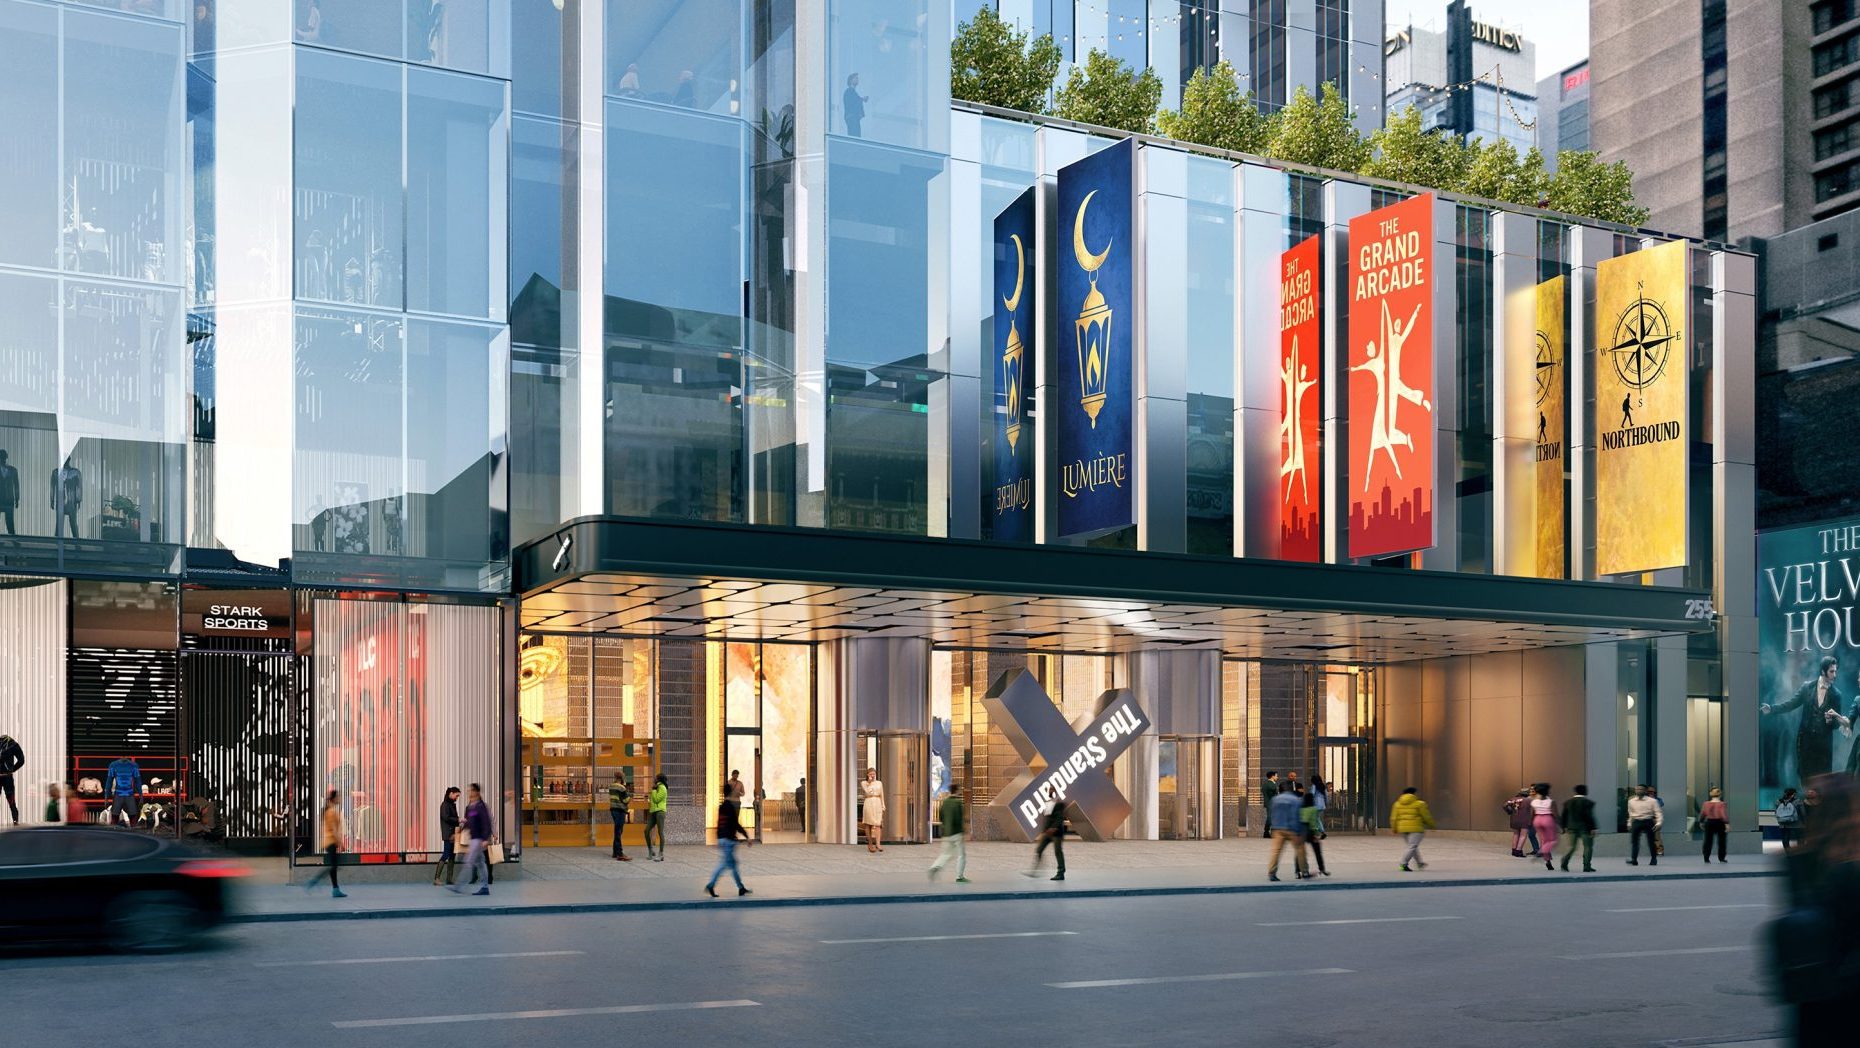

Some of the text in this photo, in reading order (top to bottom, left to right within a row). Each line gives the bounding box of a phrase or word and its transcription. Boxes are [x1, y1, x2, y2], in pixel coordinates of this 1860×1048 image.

[1379, 217, 1400, 238] THE
[1360, 230, 1420, 272] GRAND
[1355, 258, 1425, 302] ARCADE
[1637, 280, 1644, 290] N
[1600, 331, 1681, 357] W E
[1638, 398, 1643, 408] S
[1602, 420, 1680, 451] NORTHBOUND
[1063, 451, 1126, 498] LUMIÈRE
[1819, 525, 1860, 554] THE
[1764, 557, 1860, 608] VELV
[204, 617, 268, 629] SPORTS
[210, 605, 262, 617] STARK
[1685, 599, 1713, 620] 255
[1784, 606, 1860, 652] HOU
[1020, 703, 1141, 829] The Standard
